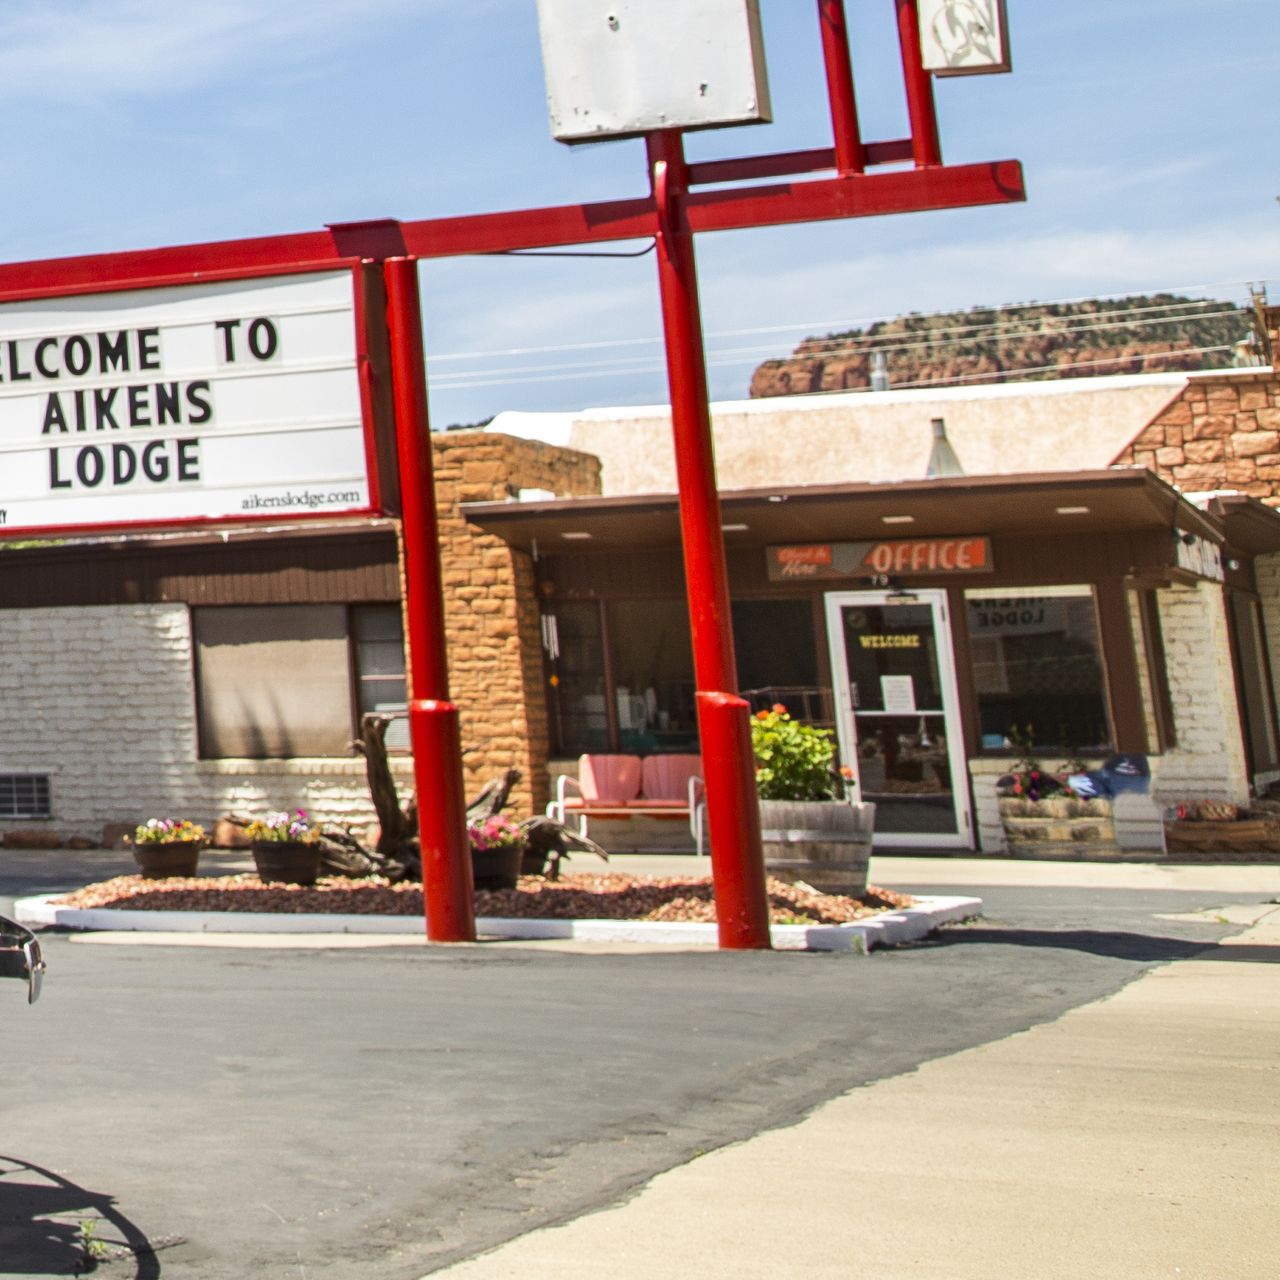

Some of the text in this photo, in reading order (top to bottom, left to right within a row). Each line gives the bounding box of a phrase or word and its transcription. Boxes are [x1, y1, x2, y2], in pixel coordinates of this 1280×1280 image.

[215, 317, 278, 363] TO
[41, 379, 213, 434] AIKENS
[48, 437, 200, 490] LODGE
[241, 490, 360, 510] aikenslodge.com
[872, 539, 975, 572] OFFICE
[859, 634, 920, 649] WELCOME
